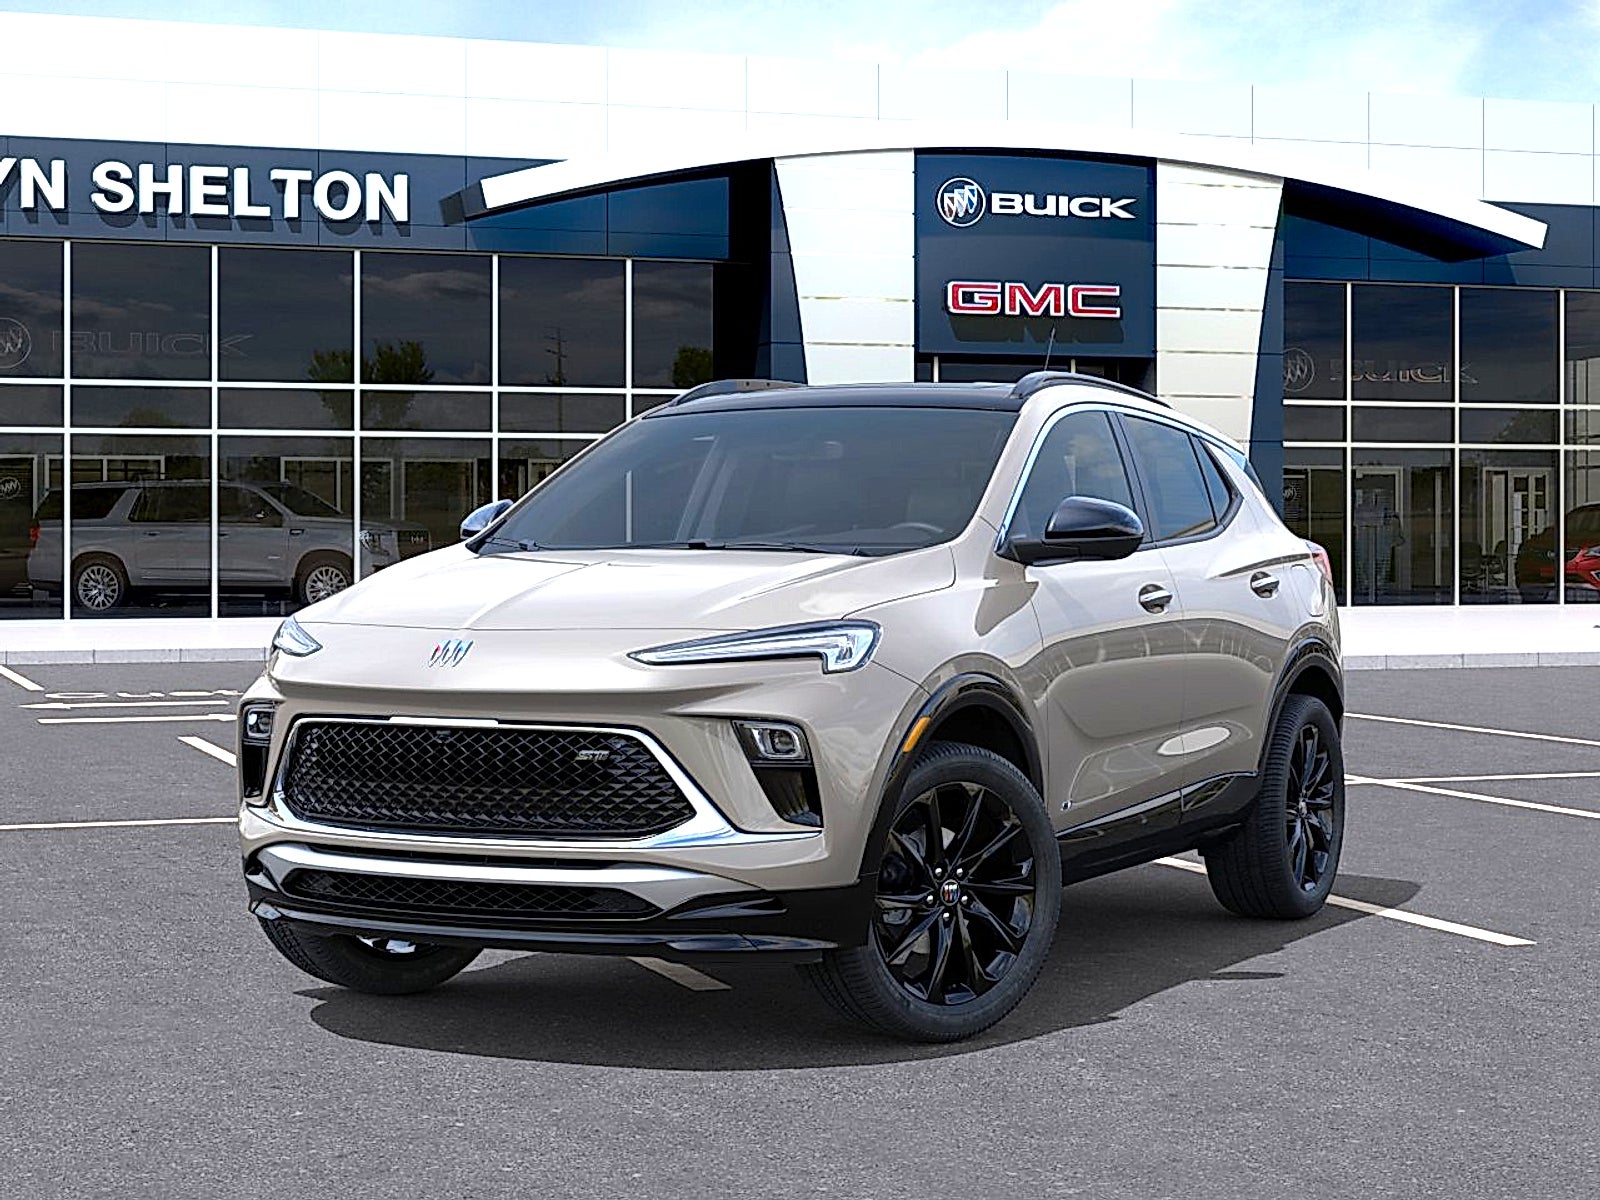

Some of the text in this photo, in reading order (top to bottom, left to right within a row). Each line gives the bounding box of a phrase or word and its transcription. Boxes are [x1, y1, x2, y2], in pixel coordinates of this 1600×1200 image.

[90, 160, 409, 222] SHELTON
[990, 192, 1137, 219] BUICK
[947, 280, 1121, 318] GMC
[52, 330, 254, 356] BUICK
